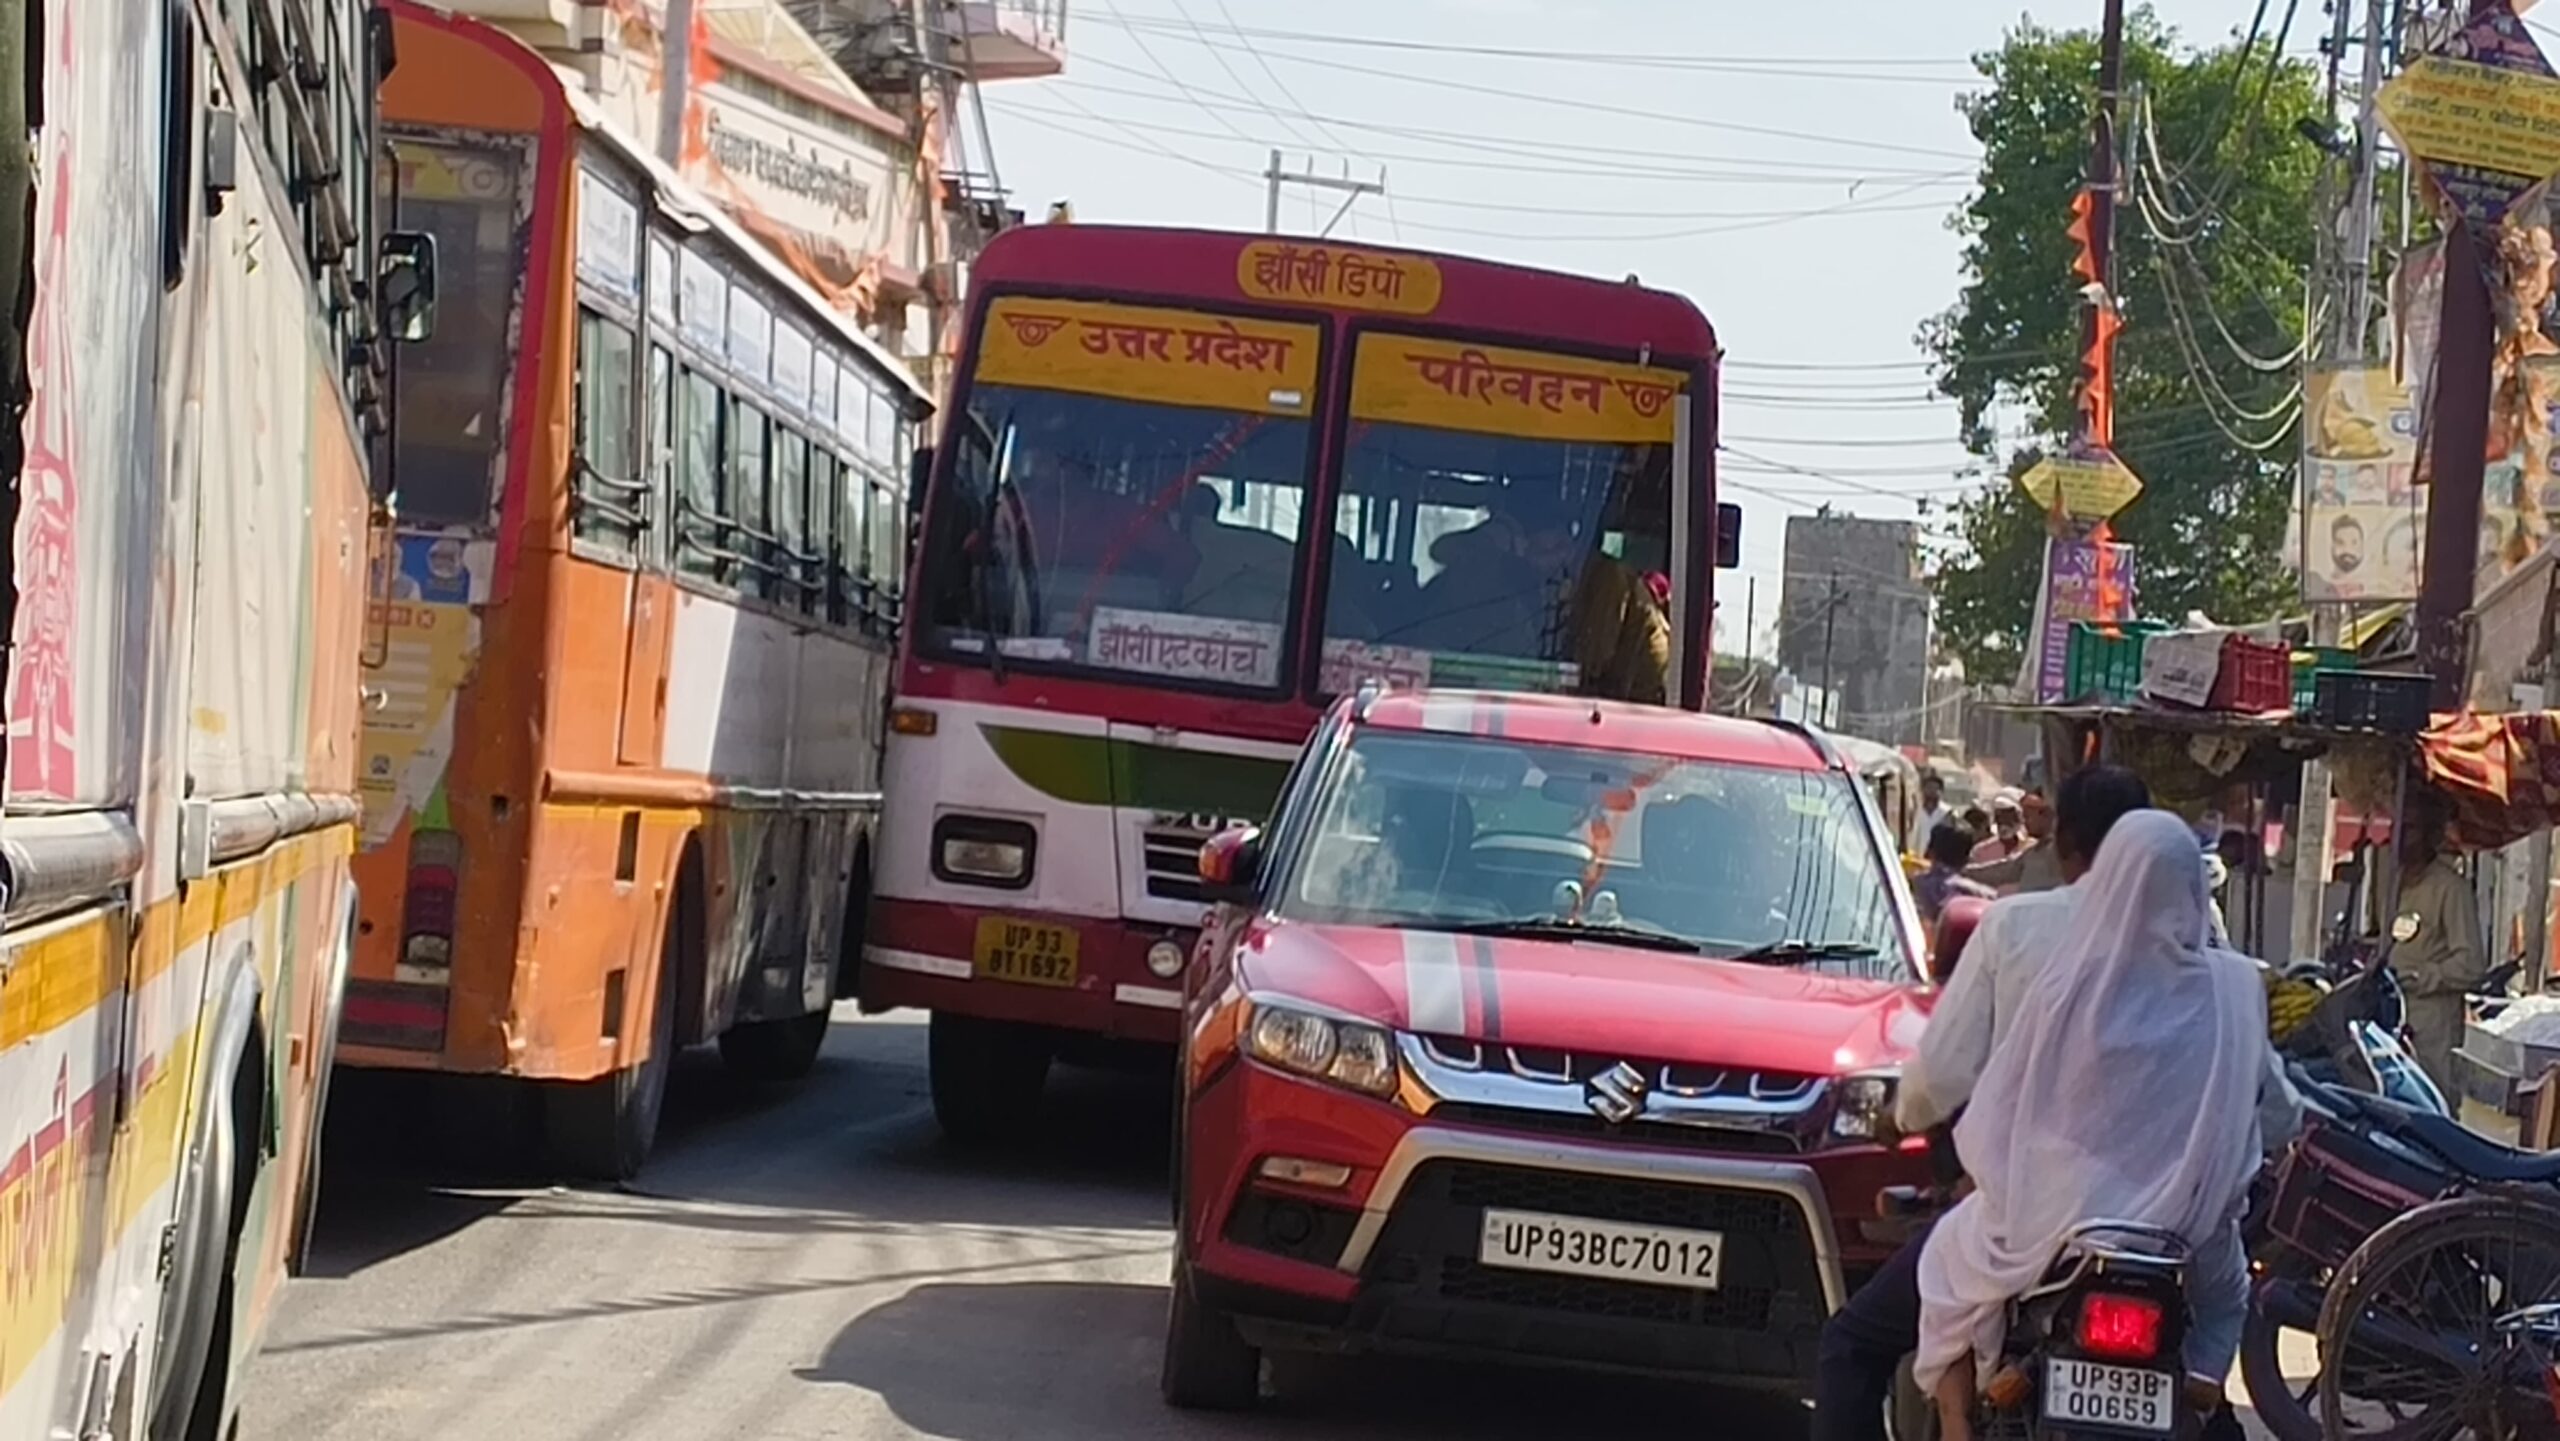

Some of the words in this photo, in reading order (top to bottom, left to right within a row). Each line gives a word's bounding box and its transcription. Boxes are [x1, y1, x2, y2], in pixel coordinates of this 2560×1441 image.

[1336, 252, 1406, 300] डिपो
[1077, 319, 1175, 362] उत्तर
[1180, 319, 1293, 374] प्रदेश
[1403, 348, 1613, 414] परिवहन
[1504, 1222, 1714, 1279] UP93BC7012
[2071, 1363, 2159, 1398] UP93B
